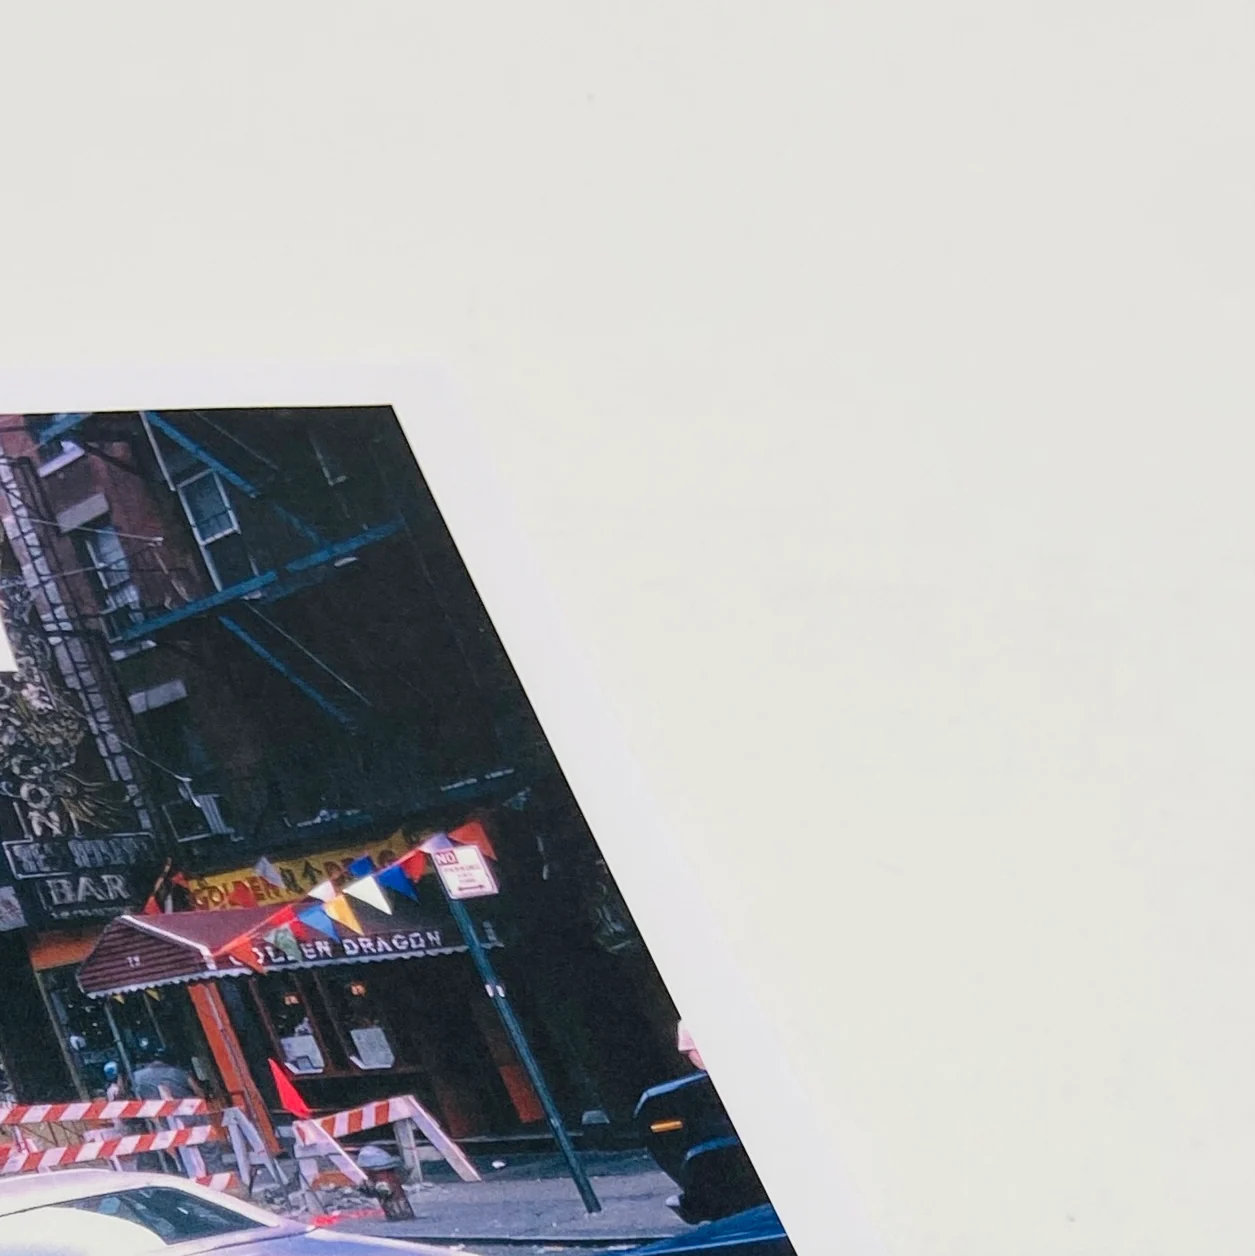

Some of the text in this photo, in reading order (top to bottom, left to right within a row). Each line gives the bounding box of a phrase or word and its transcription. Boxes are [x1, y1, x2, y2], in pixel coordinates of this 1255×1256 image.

[435, 850, 456, 865] NO
[46, 874, 131, 905] BAR
[343, 930, 443, 957] DRAGON
